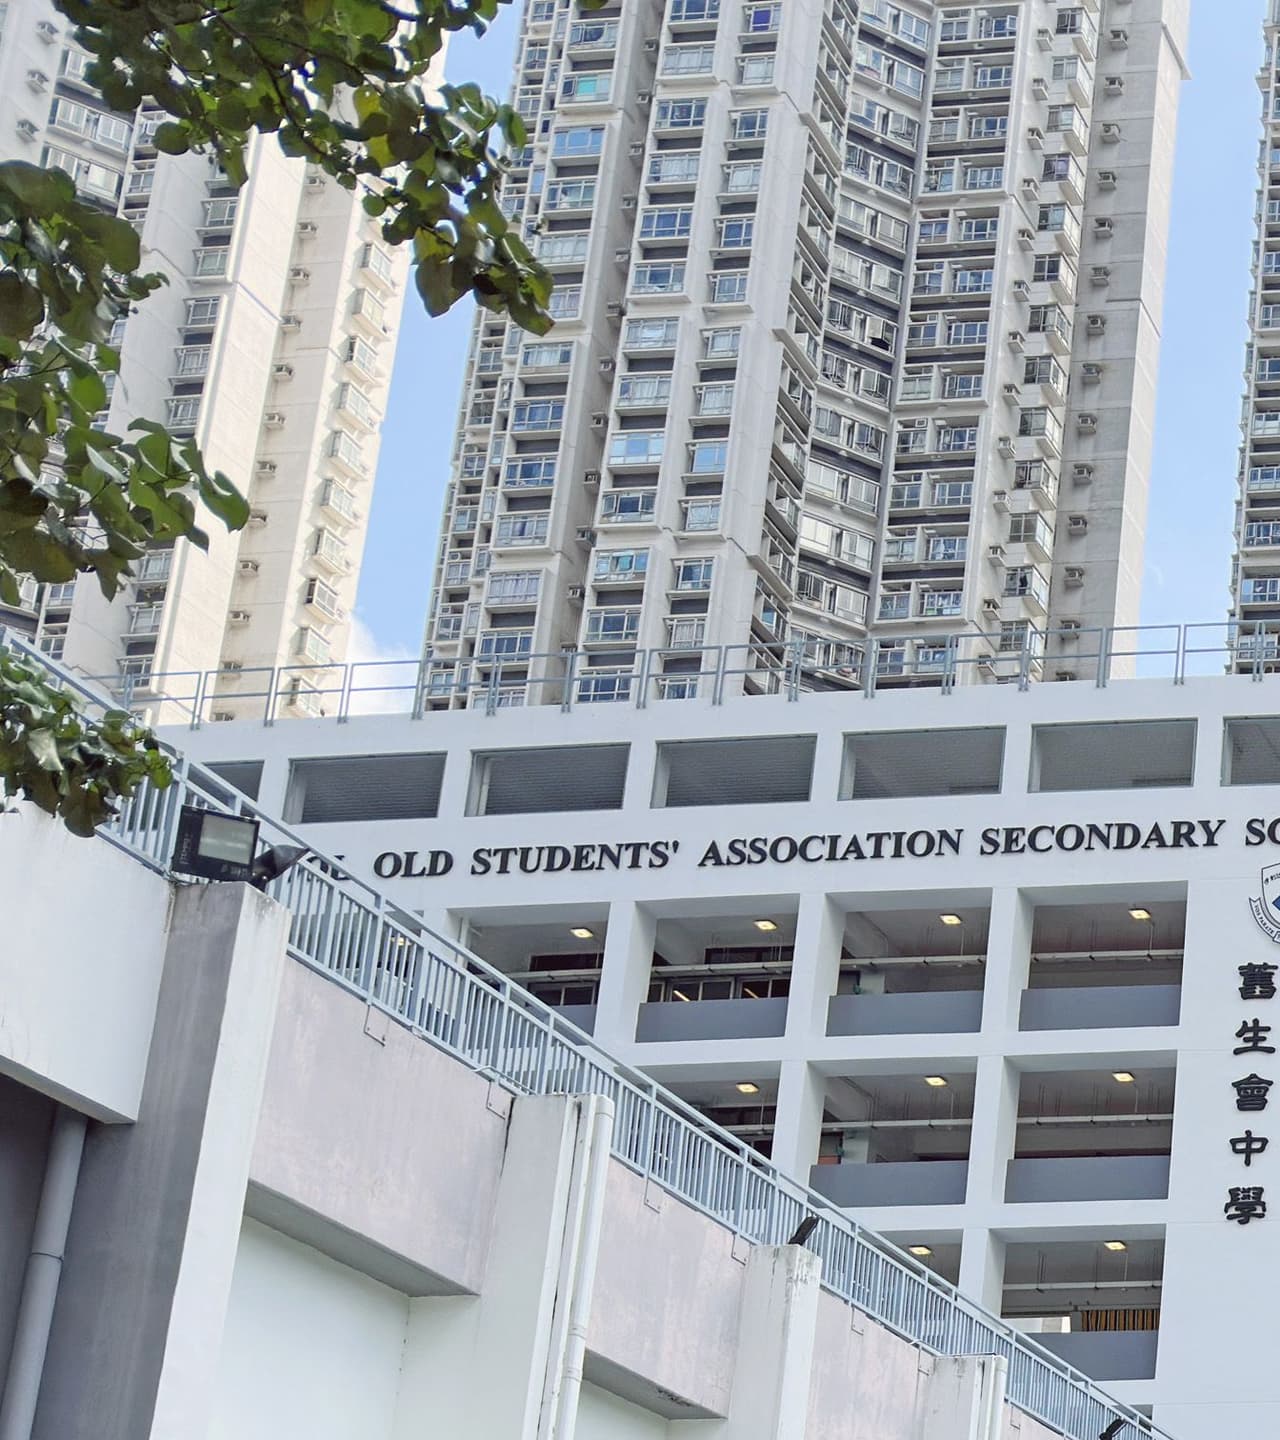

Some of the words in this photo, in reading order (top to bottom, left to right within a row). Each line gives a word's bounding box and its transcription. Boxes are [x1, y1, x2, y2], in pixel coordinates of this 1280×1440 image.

[373, 850, 454, 879] OLD
[470, 840, 680, 876] STUDENTS'
[698, 828, 963, 867] ASSOCIATION
[979, 817, 1228, 857] SECONDARY
[1224, 962, 1280, 1225] 舊生會中學
